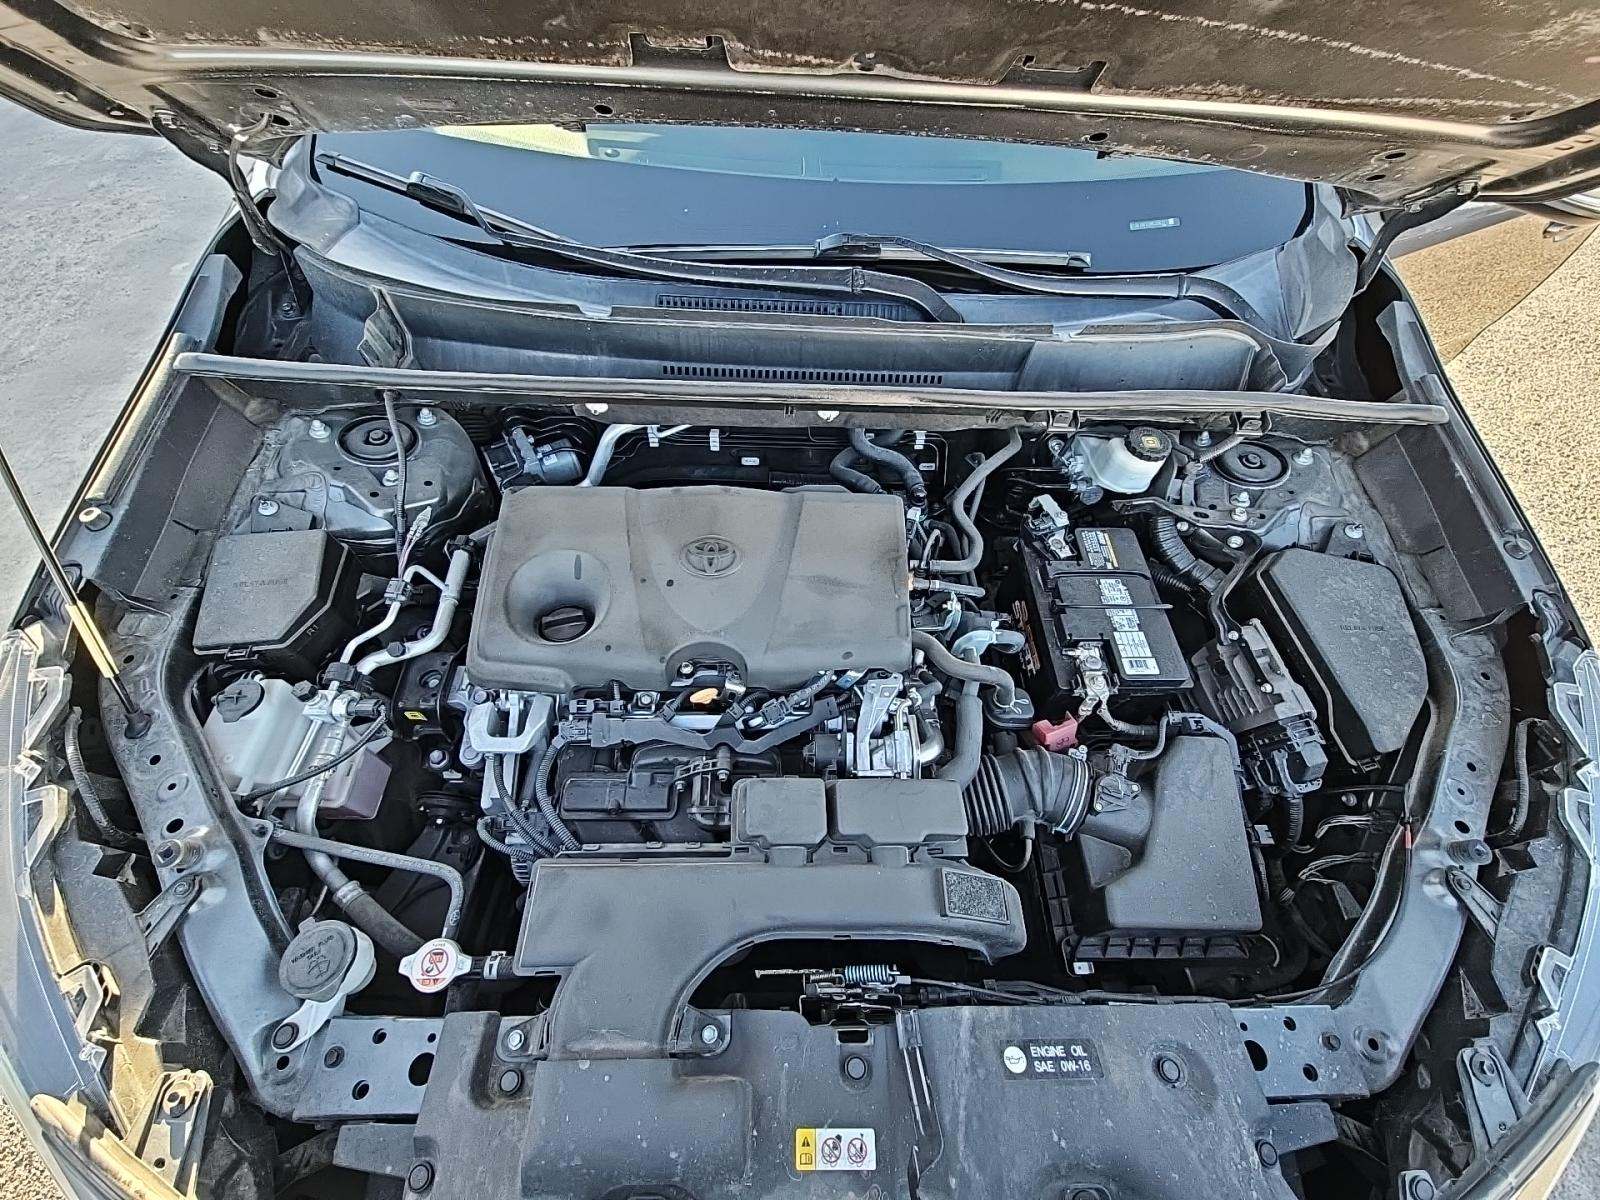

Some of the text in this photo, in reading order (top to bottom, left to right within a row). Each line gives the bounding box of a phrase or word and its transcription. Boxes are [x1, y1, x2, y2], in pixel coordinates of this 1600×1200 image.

[1030, 1045, 1088, 1057] ENGINE OIL
[1034, 1060, 1092, 1072] SAE 0W-16
